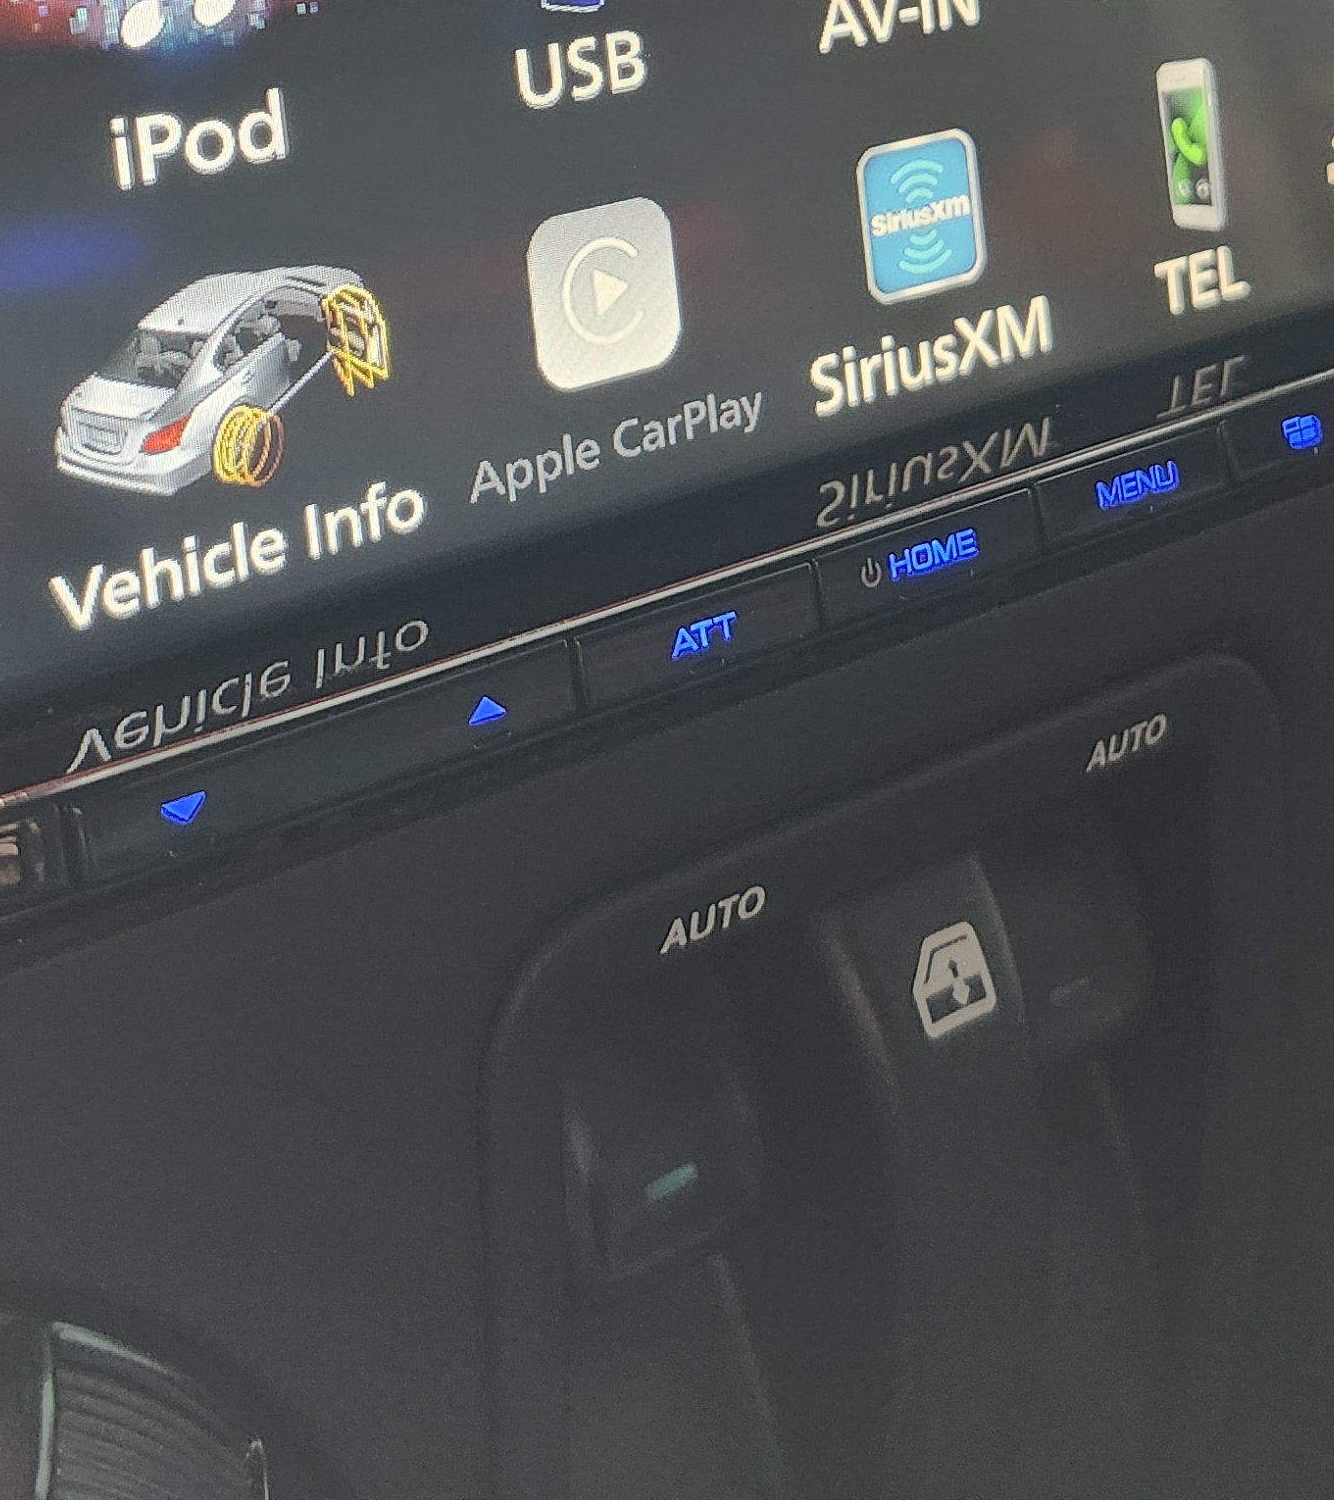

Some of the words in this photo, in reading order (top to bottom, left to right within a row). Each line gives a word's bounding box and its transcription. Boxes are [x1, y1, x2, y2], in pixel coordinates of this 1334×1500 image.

[514, 30, 649, 109] USB
[110, 87, 290, 191] iPod
[1154, 245, 1251, 315] TEL
[810, 296, 1055, 417] SiriusXM
[469, 433, 601, 504] Apple
[614, 391, 764, 460] CarPlay
[1095, 460, 1179, 510] MENU
[50, 519, 288, 631] Vehicle
[306, 480, 428, 557] Info
[889, 528, 979, 581] HOME
[671, 611, 737, 660] ATT
[1085, 713, 1168, 773] AUTO
[660, 885, 768, 956] AUTO
